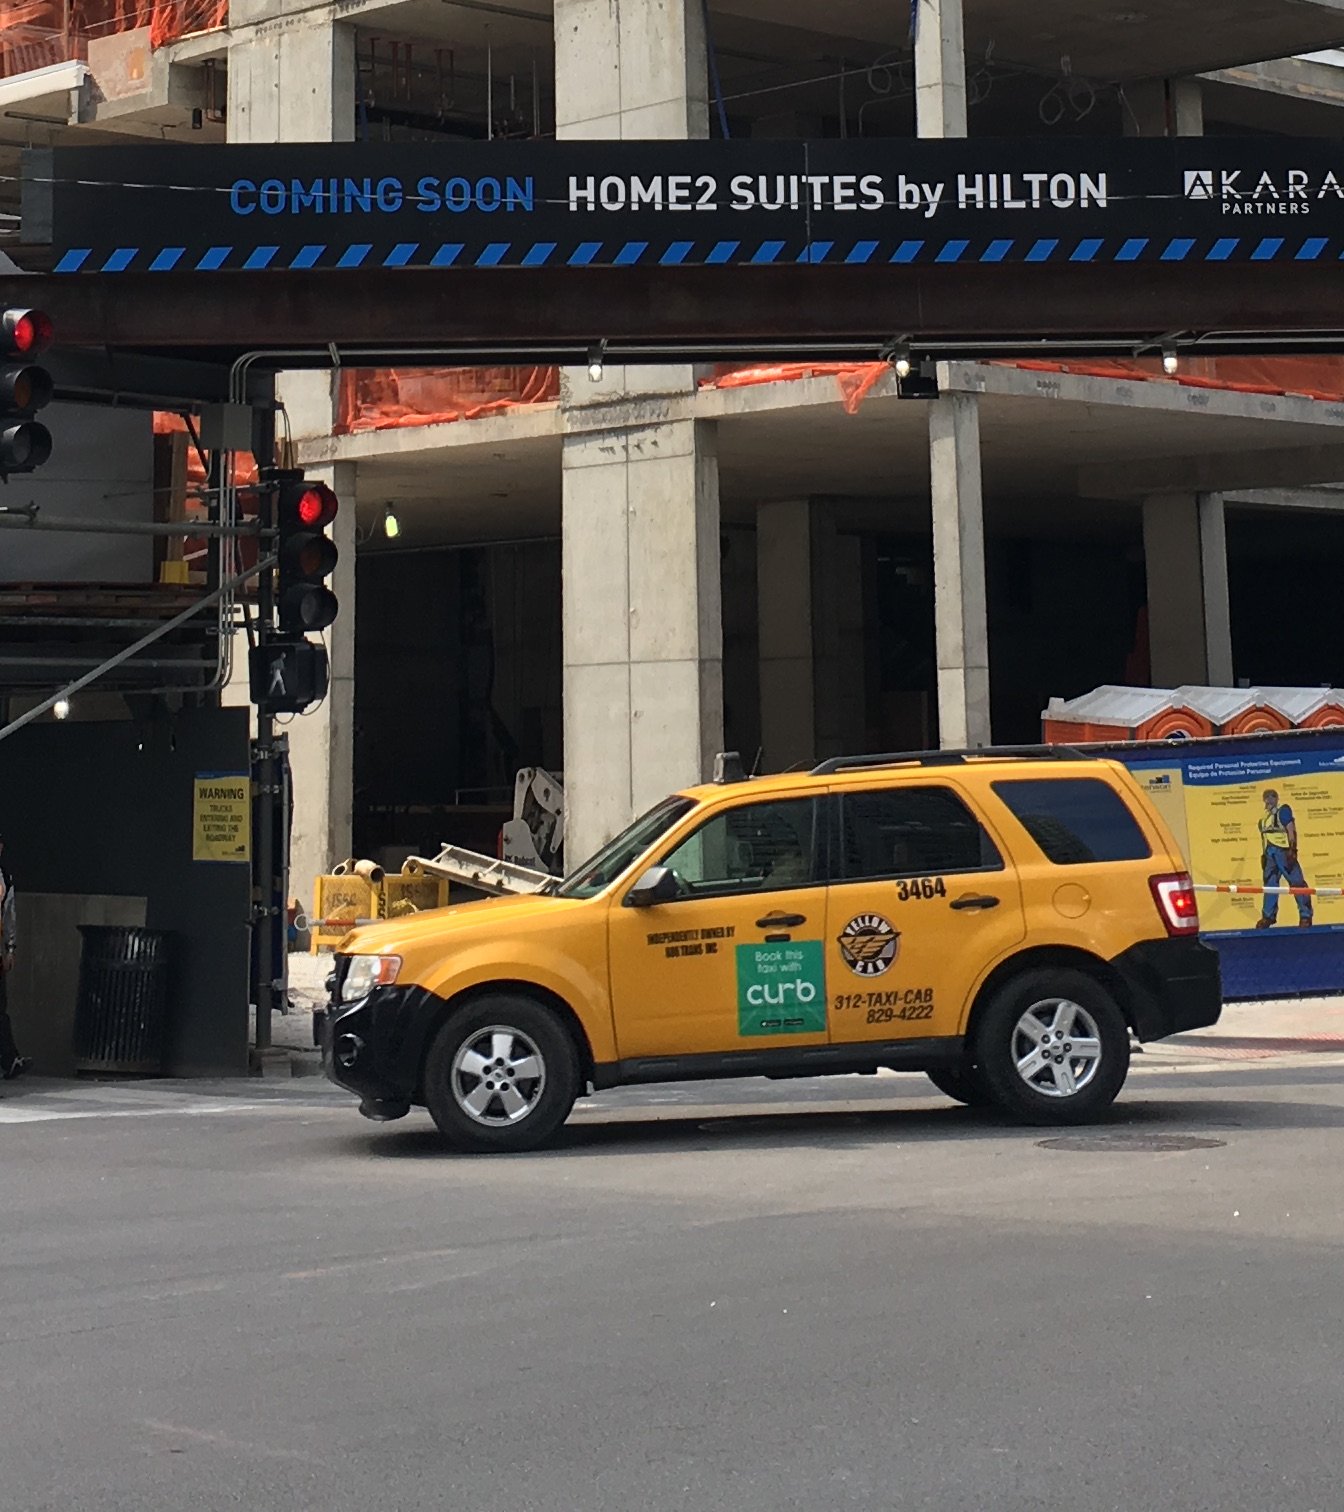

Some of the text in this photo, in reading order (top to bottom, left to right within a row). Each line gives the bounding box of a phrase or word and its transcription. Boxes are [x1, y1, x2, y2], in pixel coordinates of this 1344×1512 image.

[230, 173, 1107, 218] COMING SOON HOME2 SUITES by HILTON
[1222, 202, 1310, 216] PARTNERS
[199, 787, 244, 800] WARNING
[896, 876, 947, 902] 3464
[844, 915, 891, 937] YELLOW
[755, 949, 804, 962] Book this
[757, 961, 802, 974] taxi with
[855, 959, 886, 974] CAB
[746, 978, 816, 1006] curb
[834, 987, 934, 1010] 312-TAXI-CAB
[866, 1005, 934, 1025] 829-4222
